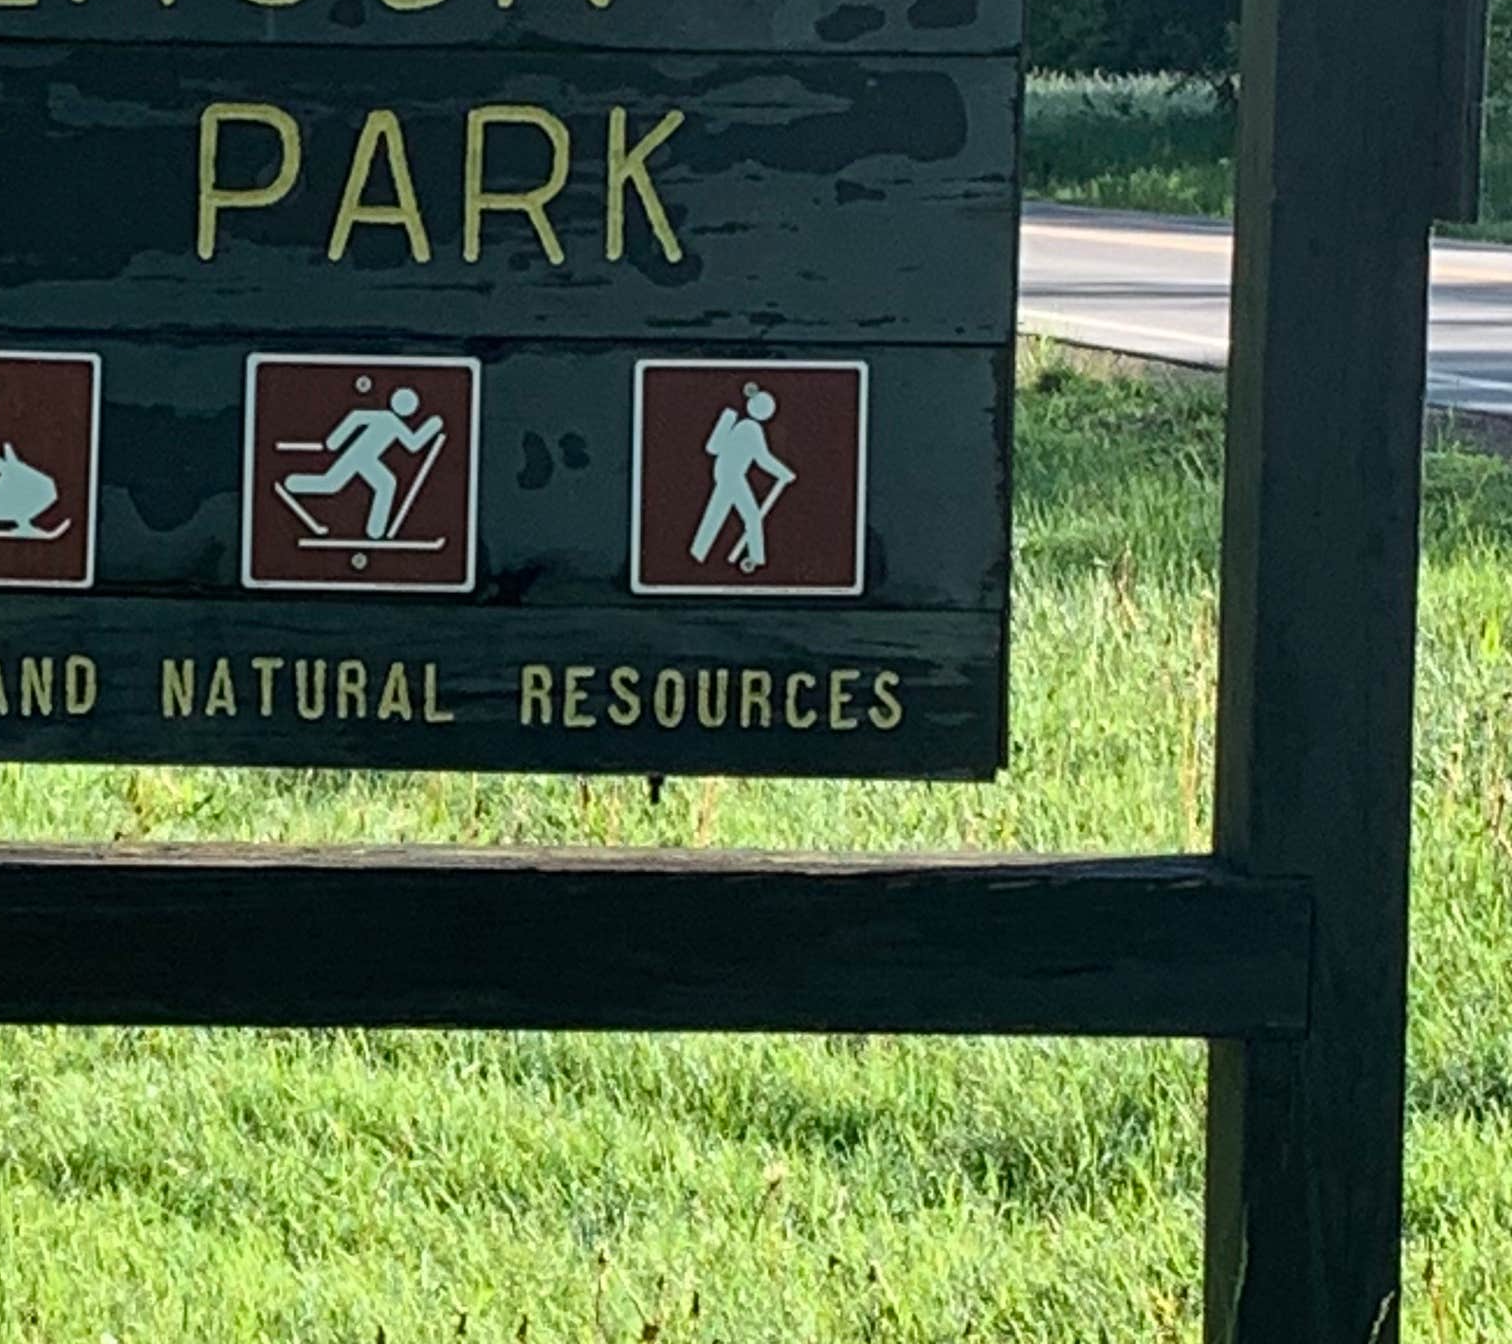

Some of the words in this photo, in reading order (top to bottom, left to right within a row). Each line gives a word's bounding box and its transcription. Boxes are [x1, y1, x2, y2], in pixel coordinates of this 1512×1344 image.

[196, 102, 686, 266] PARK
[161, 657, 455, 723] NATURAL
[520, 664, 903, 730] RESOURCES
